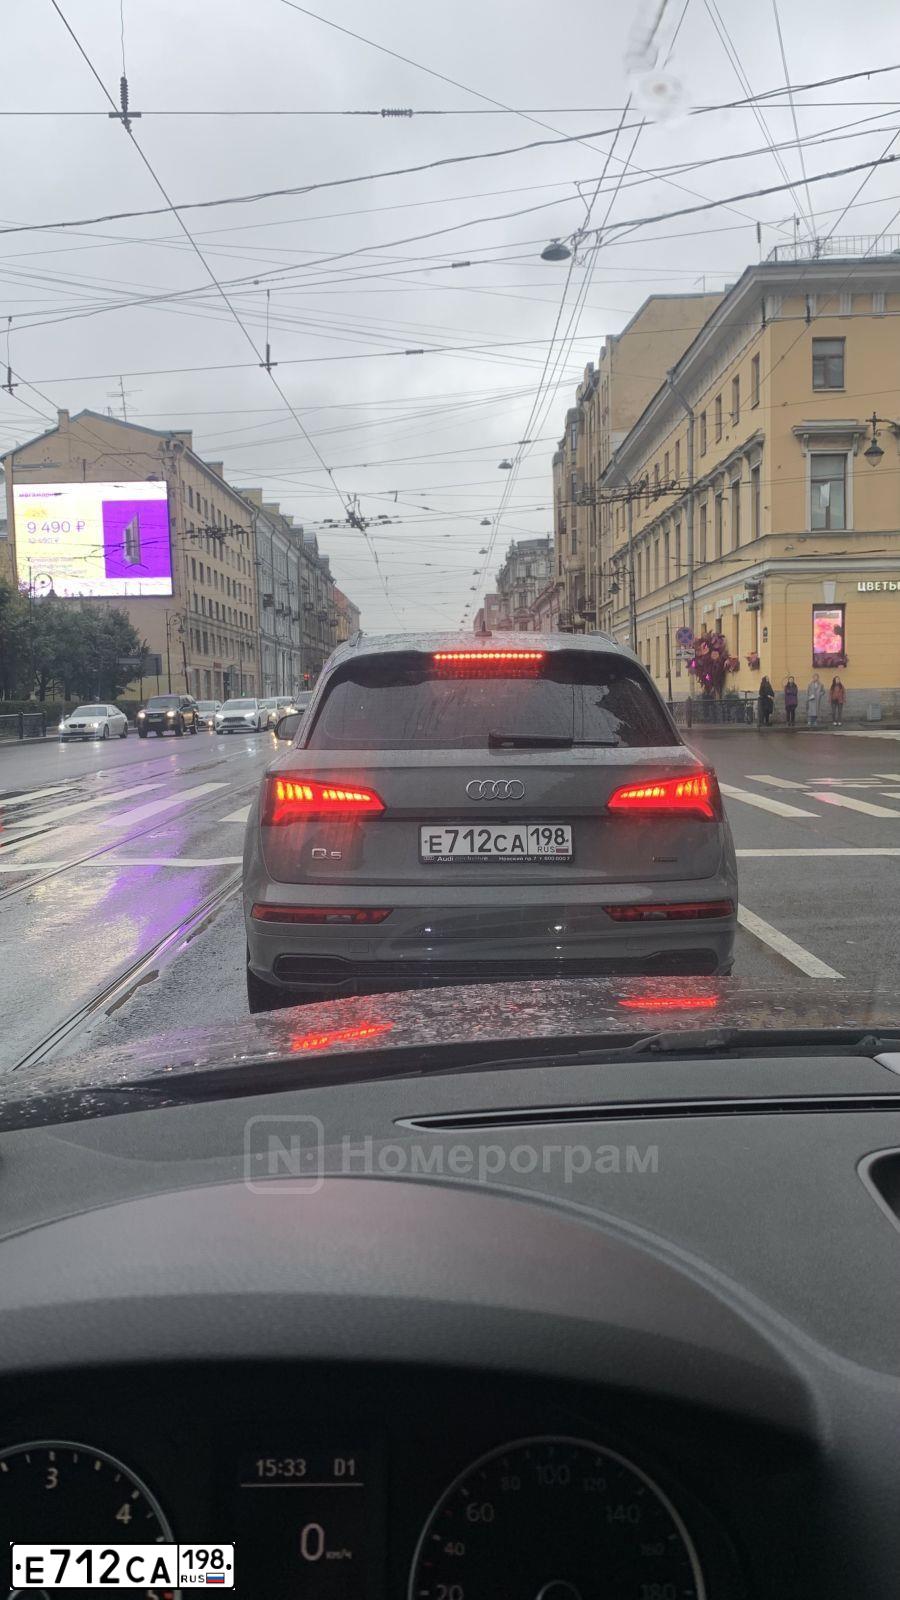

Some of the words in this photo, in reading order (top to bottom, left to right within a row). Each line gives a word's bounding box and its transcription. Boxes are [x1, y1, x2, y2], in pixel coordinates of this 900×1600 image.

[27, 521, 36, 534] 9
[41, 520, 71, 533] 490
[530, 827, 565, 846] 198
[311, 847, 342, 860] Q5
[255, 1458, 307, 1477] 15:33
[333, 1458, 356, 1477] D1
[536, 1464, 571, 1486] 100
[44, 1467, 59, 1490] 3
[115, 1503, 133, 1525] 4
[465, 1502, 495, 1523] 60
[605, 1503, 641, 1524] 140
[299, 1522, 325, 1562] 0
[443, 1541, 466, 1557] 40
[435, 1584, 464, 1600] 20
[640, 1583, 677, 1600] 180
